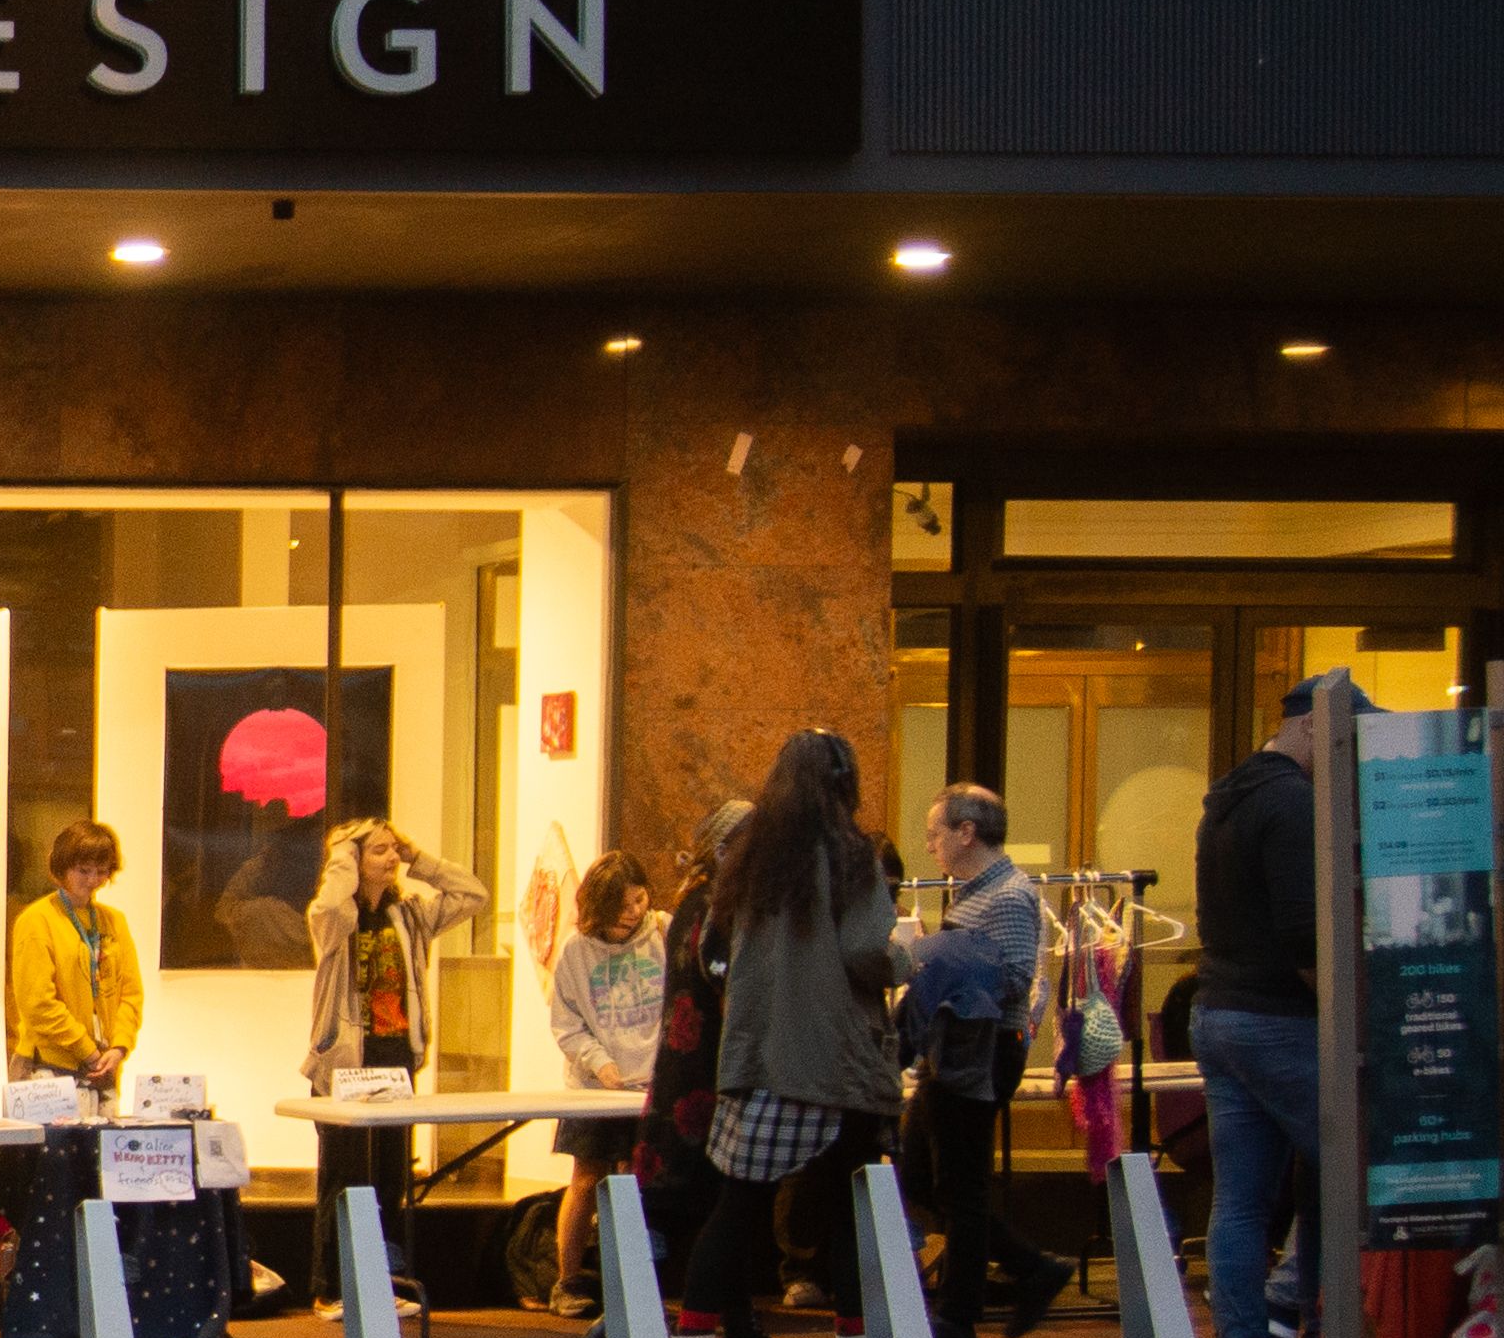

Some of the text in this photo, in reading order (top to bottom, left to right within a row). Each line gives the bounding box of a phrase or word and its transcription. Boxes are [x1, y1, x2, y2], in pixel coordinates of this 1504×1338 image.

[1399, 963, 1463, 977] 200 bikes
[1392, 1129, 1472, 1147] parking hubs
